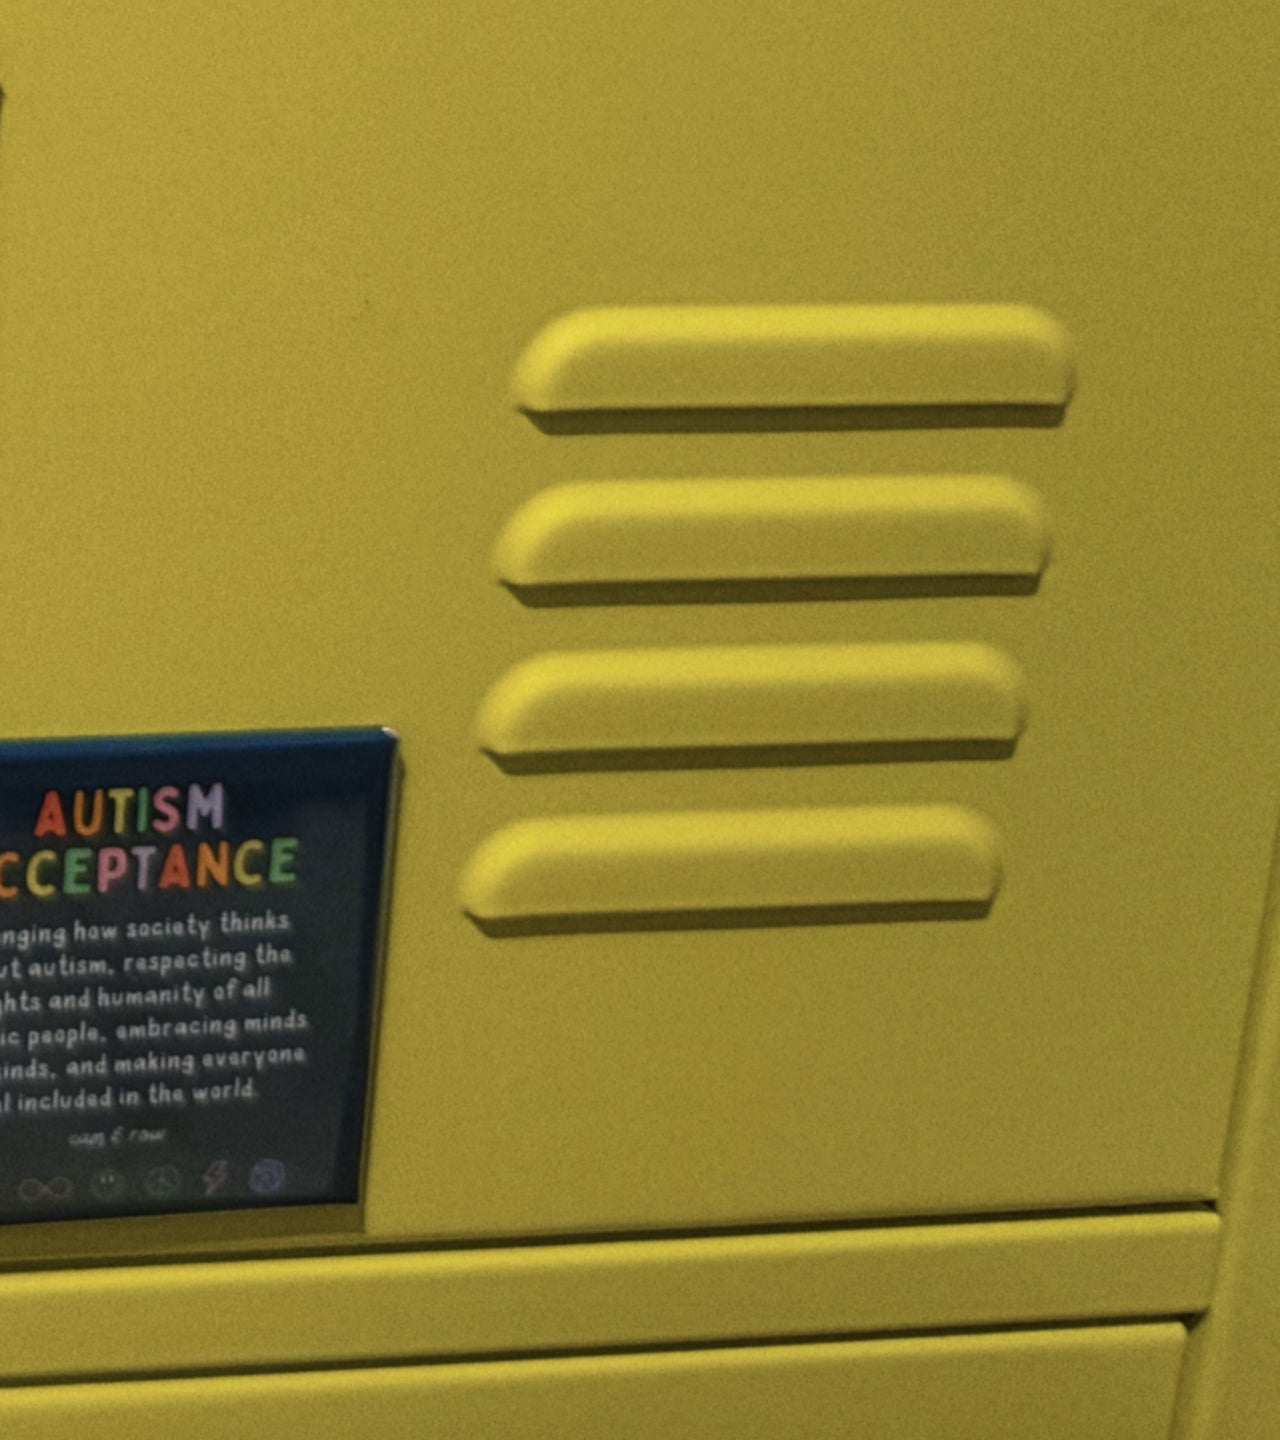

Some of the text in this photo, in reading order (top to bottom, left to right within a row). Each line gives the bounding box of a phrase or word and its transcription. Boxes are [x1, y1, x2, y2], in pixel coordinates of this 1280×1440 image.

[34, 782, 225, 839] AUTISM
[73, 920, 118, 941] how
[126, 913, 210, 940] society
[220, 909, 290, 933] thinks
[123, 947, 247, 975] respecting
[255, 943, 292, 964] the
[48, 987, 90, 1009] and
[97, 982, 206, 1010] humanity
[213, 978, 240, 1000] of
[243, 977, 271, 998] all
[116, 1017, 238, 1041] embracing
[244, 1008, 308, 1032] minds
[65, 1053, 107, 1075] and
[114, 1051, 195, 1074] making
[202, 1046, 305, 1070] everyone
[17, 1086, 112, 1110] included
[119, 1088, 140, 1105] in
[149, 1082, 184, 1103] the
